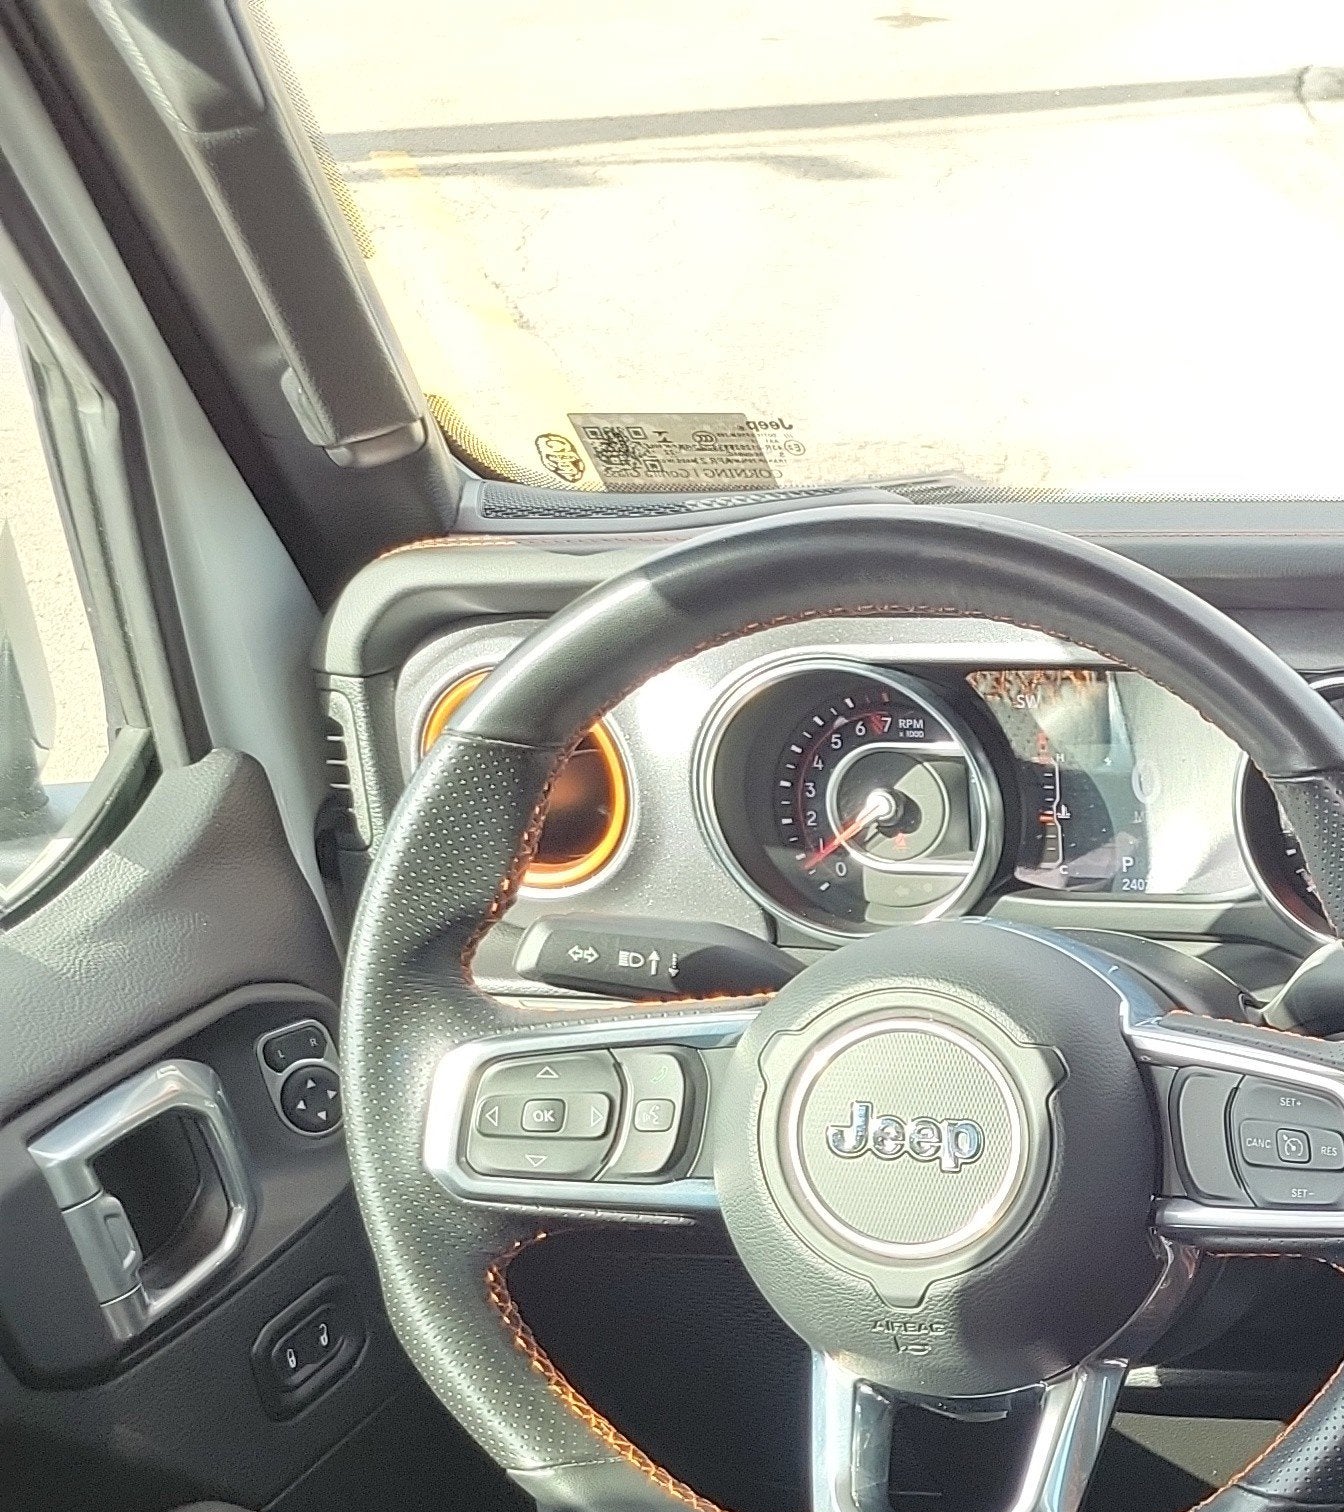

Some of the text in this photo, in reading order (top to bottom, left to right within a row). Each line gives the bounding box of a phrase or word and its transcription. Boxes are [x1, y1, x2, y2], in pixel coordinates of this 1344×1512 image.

[1015, 694, 1041, 709] SW
[855, 720, 866, 736] 6
[881, 717, 892, 733] 7
[898, 718, 924, 729] RPM
[830, 734, 842, 749] 5
[812, 755, 824, 771] 4
[805, 782, 816, 798] 3
[807, 811, 817, 827] 2
[835, 862, 847, 877] 0
[1059, 865, 1069, 875] C
[1122, 857, 1134, 873] P
[309, 1037, 318, 1047] R
[532, 1109, 555, 1123] OK
[825, 1100, 986, 1174] Jeep
[1245, 1137, 1272, 1149] CANC
[1320, 1146, 1338, 1156] RES
[870, 1319, 947, 1335] AIRBAG
